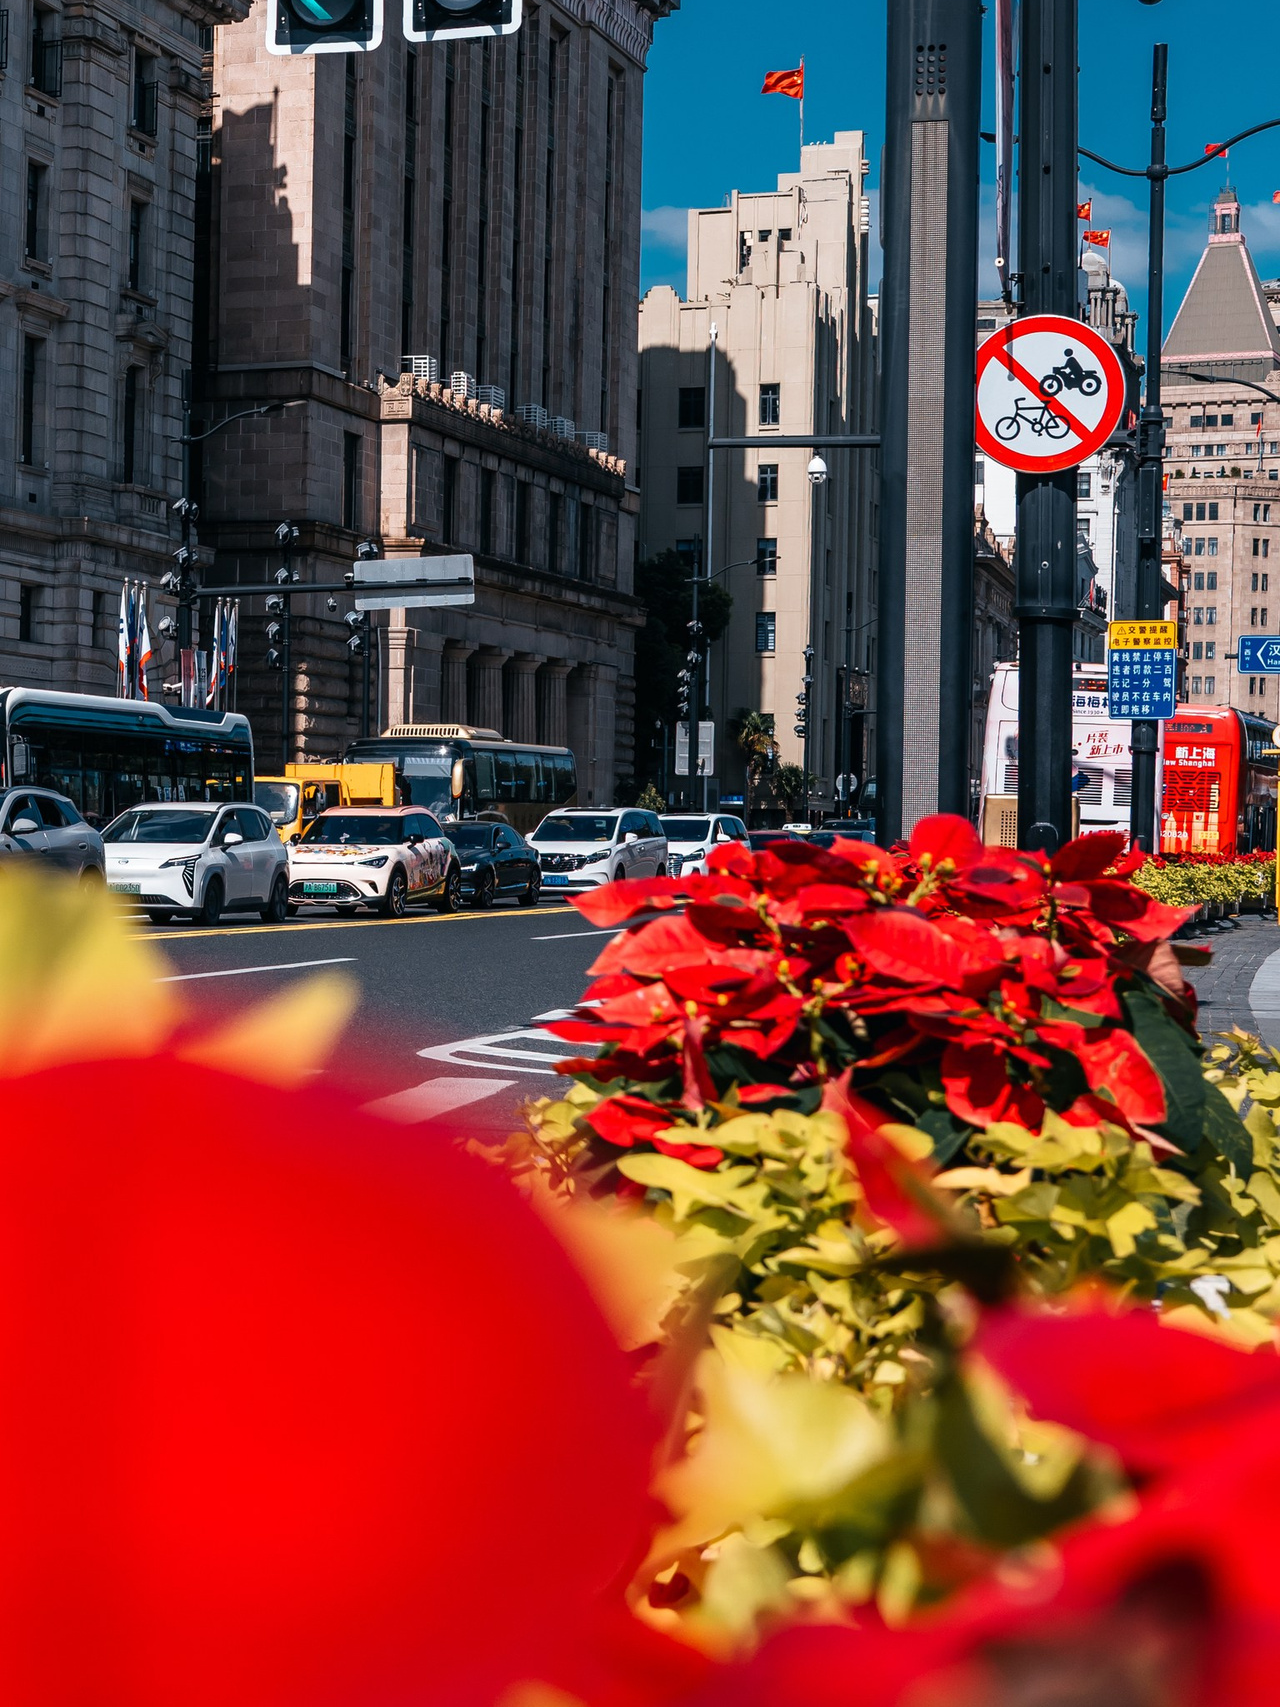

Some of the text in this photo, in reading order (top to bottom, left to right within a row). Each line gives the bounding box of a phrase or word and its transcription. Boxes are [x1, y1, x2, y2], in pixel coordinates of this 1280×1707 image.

[1128, 626, 1168, 634] 交警提醒
[1112, 638, 1172, 646] 电子警察监控
[1112, 652, 1172, 662] 黄线禁止停车
[1112, 665, 1172, 675] 违者罚款二百
[1112, 692, 1171, 702] 驶员不在车内
[1175, 746, 1216, 760] 新上海
[1178, 759, 1215, 769] Shanghai
